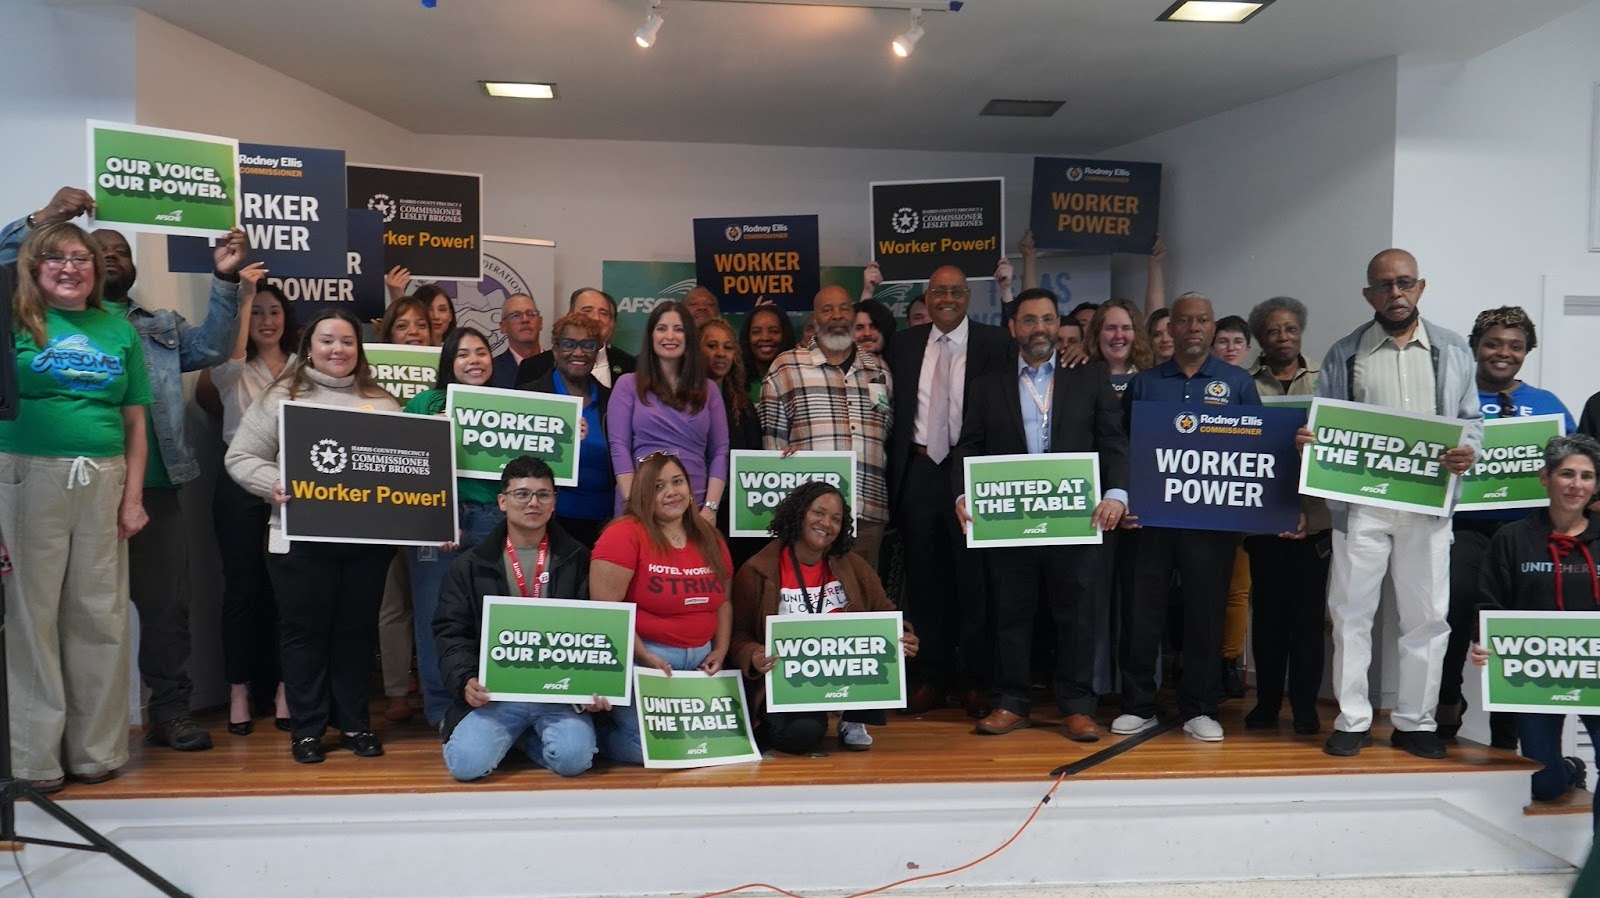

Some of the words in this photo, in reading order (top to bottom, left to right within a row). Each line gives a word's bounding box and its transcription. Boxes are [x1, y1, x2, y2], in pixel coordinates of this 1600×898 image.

[105, 157, 151, 176] OUR
[155, 162, 221, 183] VOICE.
[239, 154, 279, 168] Rodney
[281, 157, 303, 168] Ellis
[98, 173, 144, 191] OUR
[149, 178, 227, 199] POWER.
[241, 192, 319, 222] RKER
[400, 205, 461, 216] COMMISSIONER
[1051, 191, 1139, 214] WORKER
[400, 213, 427, 222] LESLEY
[428, 215, 462, 223] BRIONES
[922, 213, 983, 223] COMMISSIONER
[922, 220, 949, 229] LESLEY
[1057, 214, 1130, 235] POWER
[243, 224, 310, 251] WER
[383, 230, 415, 246] rker
[419, 231, 475, 249] Power!
[879, 240, 937, 254] Worker
[941, 236, 996, 252] Power!
[714, 251, 800, 272] WORKER
[723, 275, 793, 295] POWER
[368, 364, 436, 383] ORKER
[455, 407, 565, 435] WORKER
[1200, 414, 1240, 427] Rodney
[1241, 416, 1263, 426] Ellis
[1200, 426, 1262, 435] COMMISSIONER
[462, 428, 555, 454] POWER
[1317, 427, 1406, 453] UNITED
[1409, 441, 1445, 459] AT
[351, 453, 430, 467] COMMISSIONER
[397, 449, 425, 457] PRECINCT
[1313, 445, 1359, 466] THE
[1364, 452, 1440, 477] TABLE
[1481, 445, 1544, 461] VOICE.
[352, 461, 387, 472] LESLEY
[388, 464, 431, 476] BRIONES
[1155, 448, 1276, 479] WORKER
[291, 479, 371, 503] Worker
[376, 485, 448, 507] Power!
[975, 480, 1053, 498] UNITED
[1057, 479, 1085, 494] AT
[1164, 478, 1264, 508] POWER
[975, 498, 1016, 514] THE
[1020, 496, 1087, 512] TABLE
[648, 563, 682, 575] HOTEL
[683, 566, 712, 575] WORK
[647, 575, 726, 595] STRIK
[498, 630, 541, 646] OUR
[545, 632, 612, 649] VOICE.
[775, 636, 887, 657] WORKER
[1491, 636, 1600, 657] WORKE
[490, 646, 533, 661] OUR
[538, 648, 618, 665] POWER.
[785, 657, 879, 678] POWER
[1503, 658, 1600, 679] POWE
[643, 696, 706, 714] UNITED
[710, 697, 733, 712] AT
[645, 714, 678, 731] THE
[679, 714, 738, 731] TABLE
